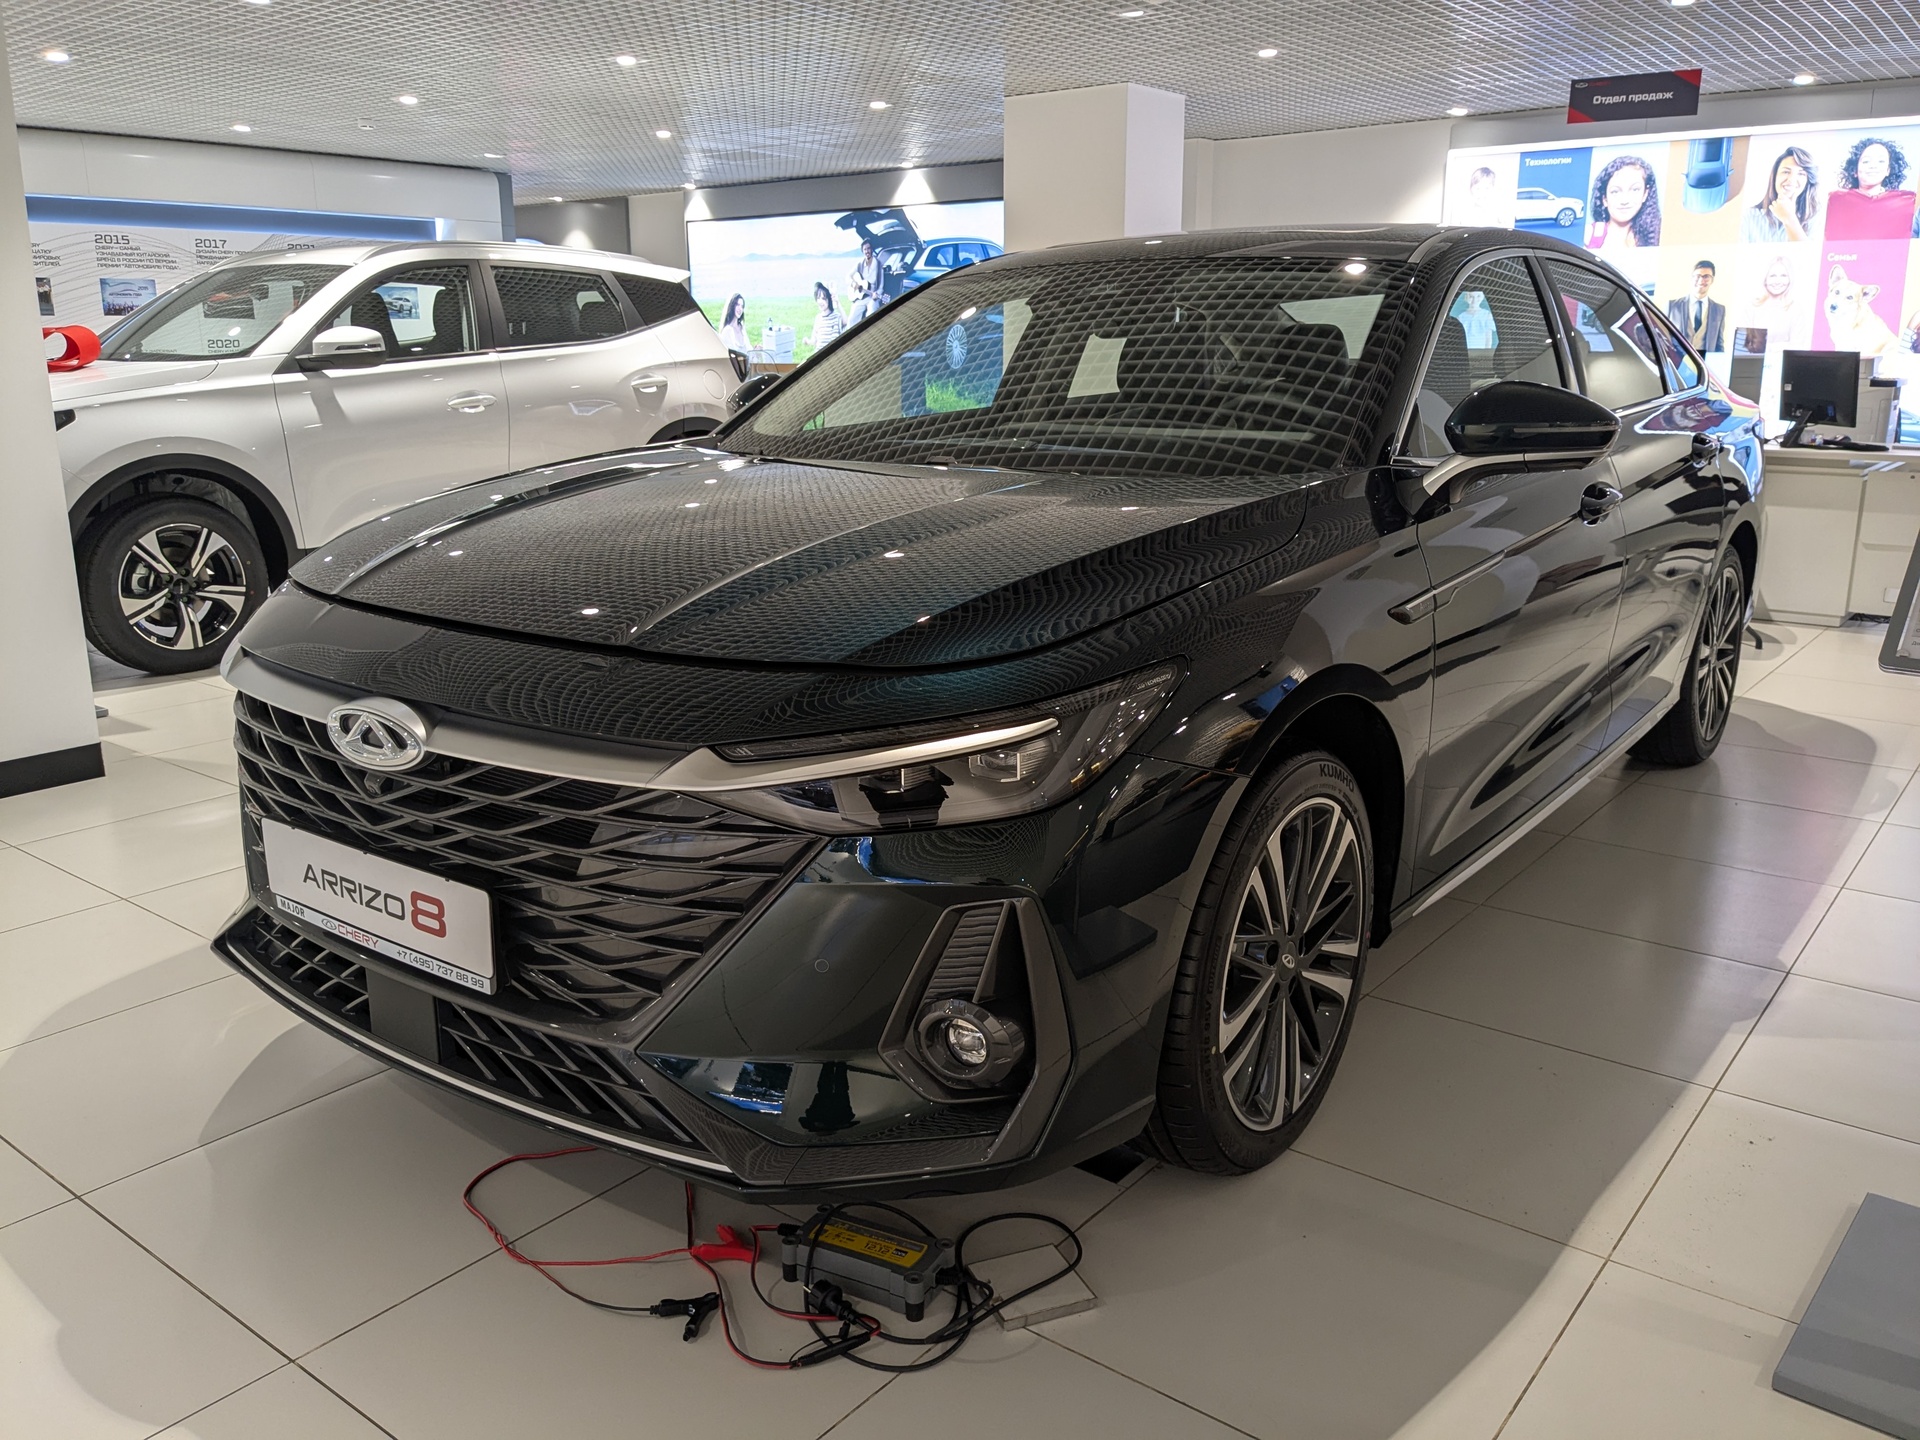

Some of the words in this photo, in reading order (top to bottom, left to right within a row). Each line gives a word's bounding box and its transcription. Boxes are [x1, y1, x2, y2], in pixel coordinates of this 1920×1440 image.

[1592, 95, 1626, 105] Отдел
[1628, 91, 1674, 103] продаж
[1525, 157, 1572, 167] Технологии
[94, 234, 130, 244] 2015
[195, 238, 227, 249] 2017
[1827, 253, 1858, 261] Семья
[207, 339, 240, 349] 2020
[1319, 763, 1354, 792] KUMHO
[303, 864, 405, 921] ARRIZO
[410, 890, 447, 938] 8
[280, 899, 306, 918] MAJOR
[337, 923, 379, 949] CHERY
[397, 949, 408, 959] +7
[408, 952, 435, 971] (495)
[435, 963, 454, 977] 737
[456, 971, 469, 983] 88
[470, 977, 484, 989] 99
